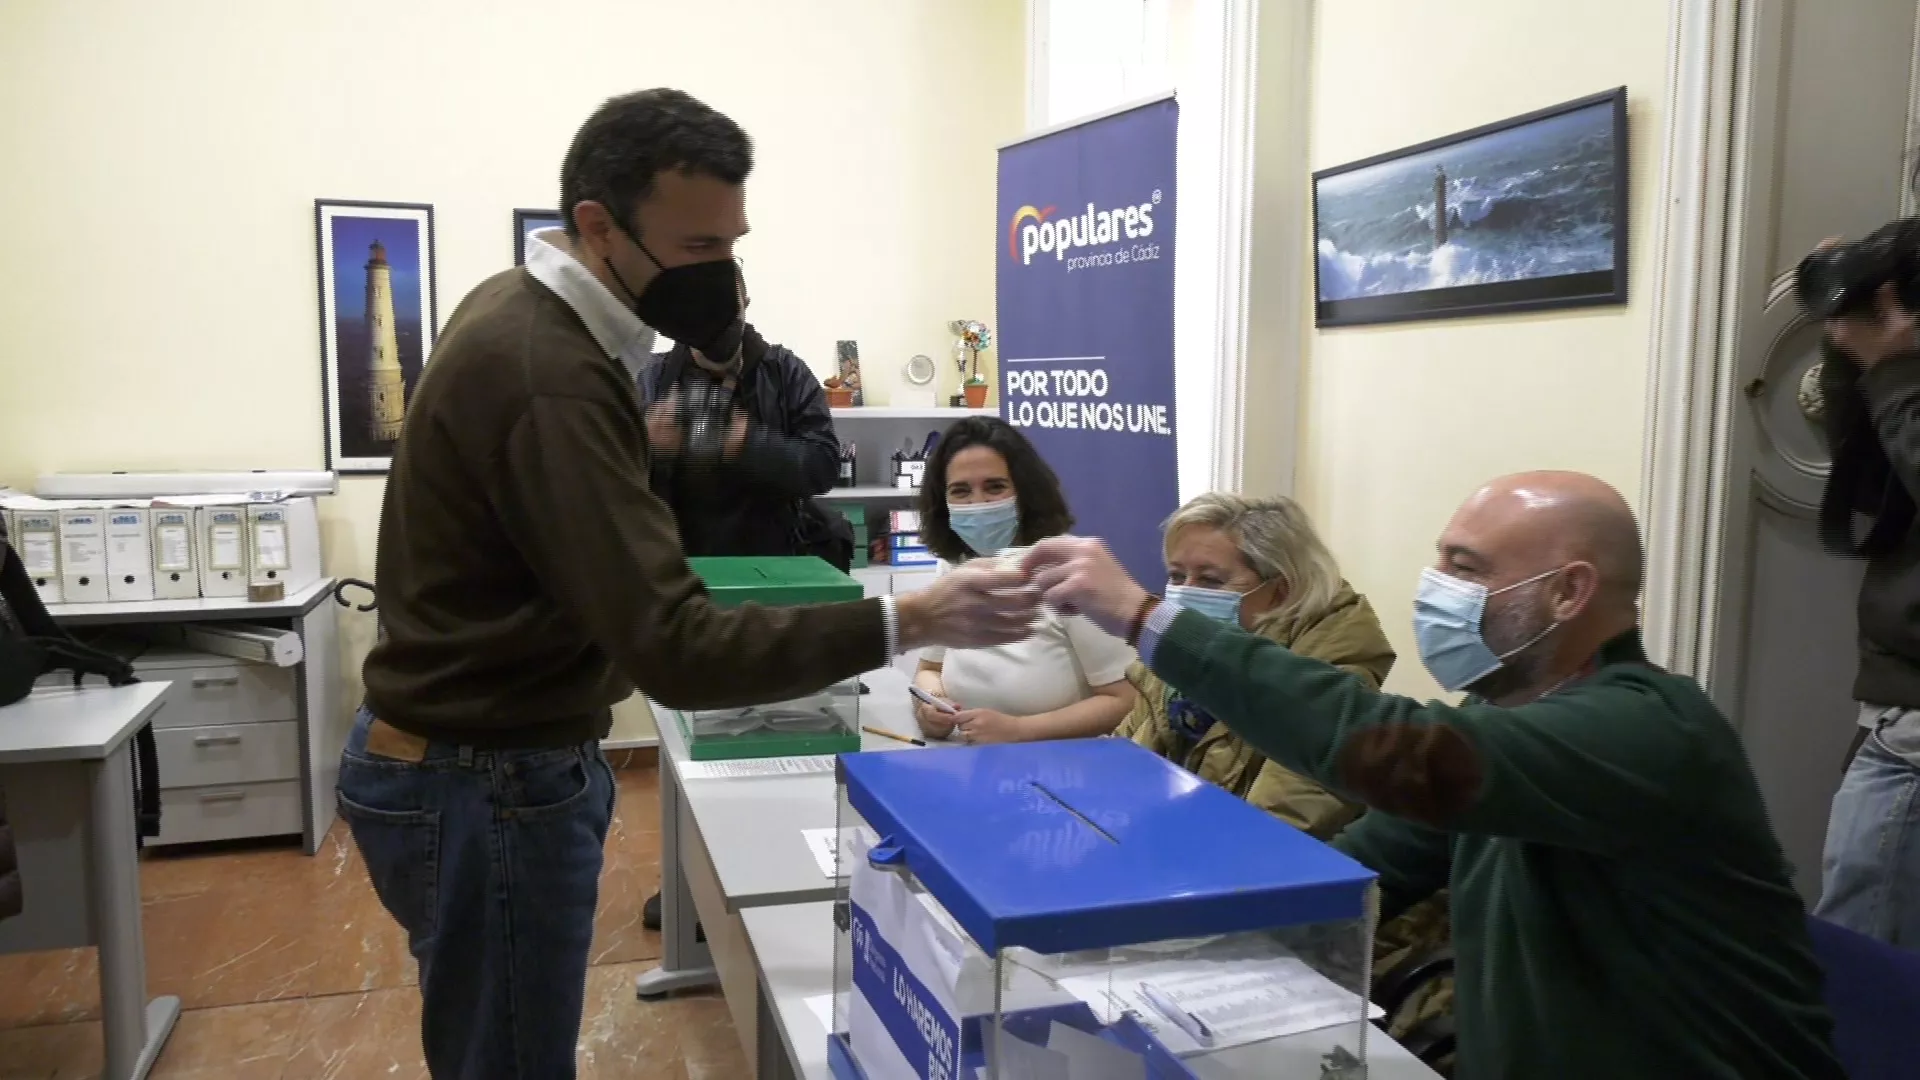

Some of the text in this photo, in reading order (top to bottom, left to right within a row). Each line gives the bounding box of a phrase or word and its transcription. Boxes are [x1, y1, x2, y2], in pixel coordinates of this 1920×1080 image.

[1022, 202, 1154, 265] populares
[1067, 241, 1161, 274] provincia de Cádiz
[1006, 368, 1109, 397] POR TODO
[1007, 400, 1172, 436] LO QUE NOS UNE.
[893, 966, 953, 1074] LO HAREMOS
[928, 1048, 951, 1080] BIE
